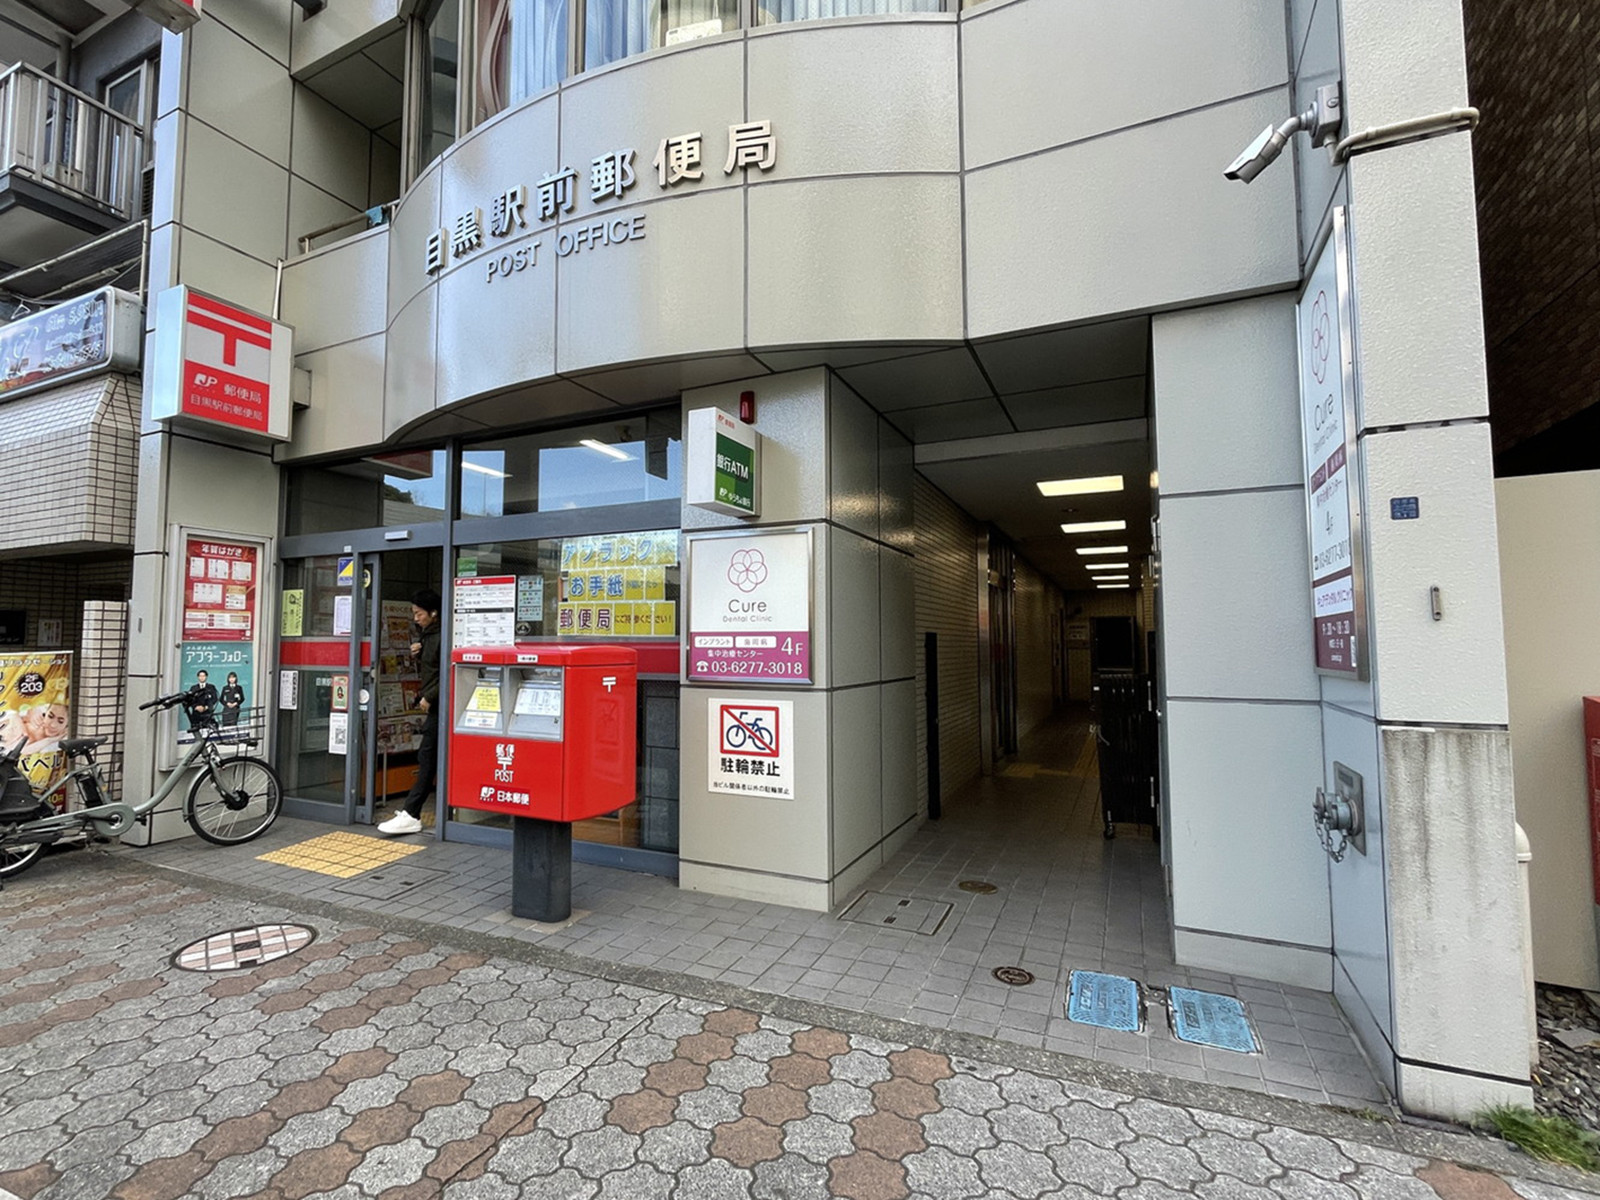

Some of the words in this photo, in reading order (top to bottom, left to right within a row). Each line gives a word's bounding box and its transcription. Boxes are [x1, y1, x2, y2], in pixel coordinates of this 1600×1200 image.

[425, 119, 777, 276] 目黒駅前郵便局
[486, 241, 541, 283] POST
[554, 213, 646, 257] OFFICE
[223, 383, 262, 405] 郵便局
[190, 393, 264, 422] 目黒駅前郵便局
[716, 453, 749, 480] 銀行ATM
[201, 544, 243, 557] 年賀はがき
[563, 539, 652, 565] アフラック
[728, 599, 767, 614] Cure
[722, 615, 748, 623] Dental
[707, 649, 763, 658] 集中治療センター
[781, 636, 804, 656] 4F
[186, 650, 249, 664] アフターフォロー
[711, 660, 803, 675] 03-6277-3018
[20, 682, 43, 693] 203
[495, 743, 515, 759] 郵便
[720, 757, 780, 777] 駐輪禁止
[494, 769, 514, 783] POST
[497, 790, 530, 806] 日本郵便
